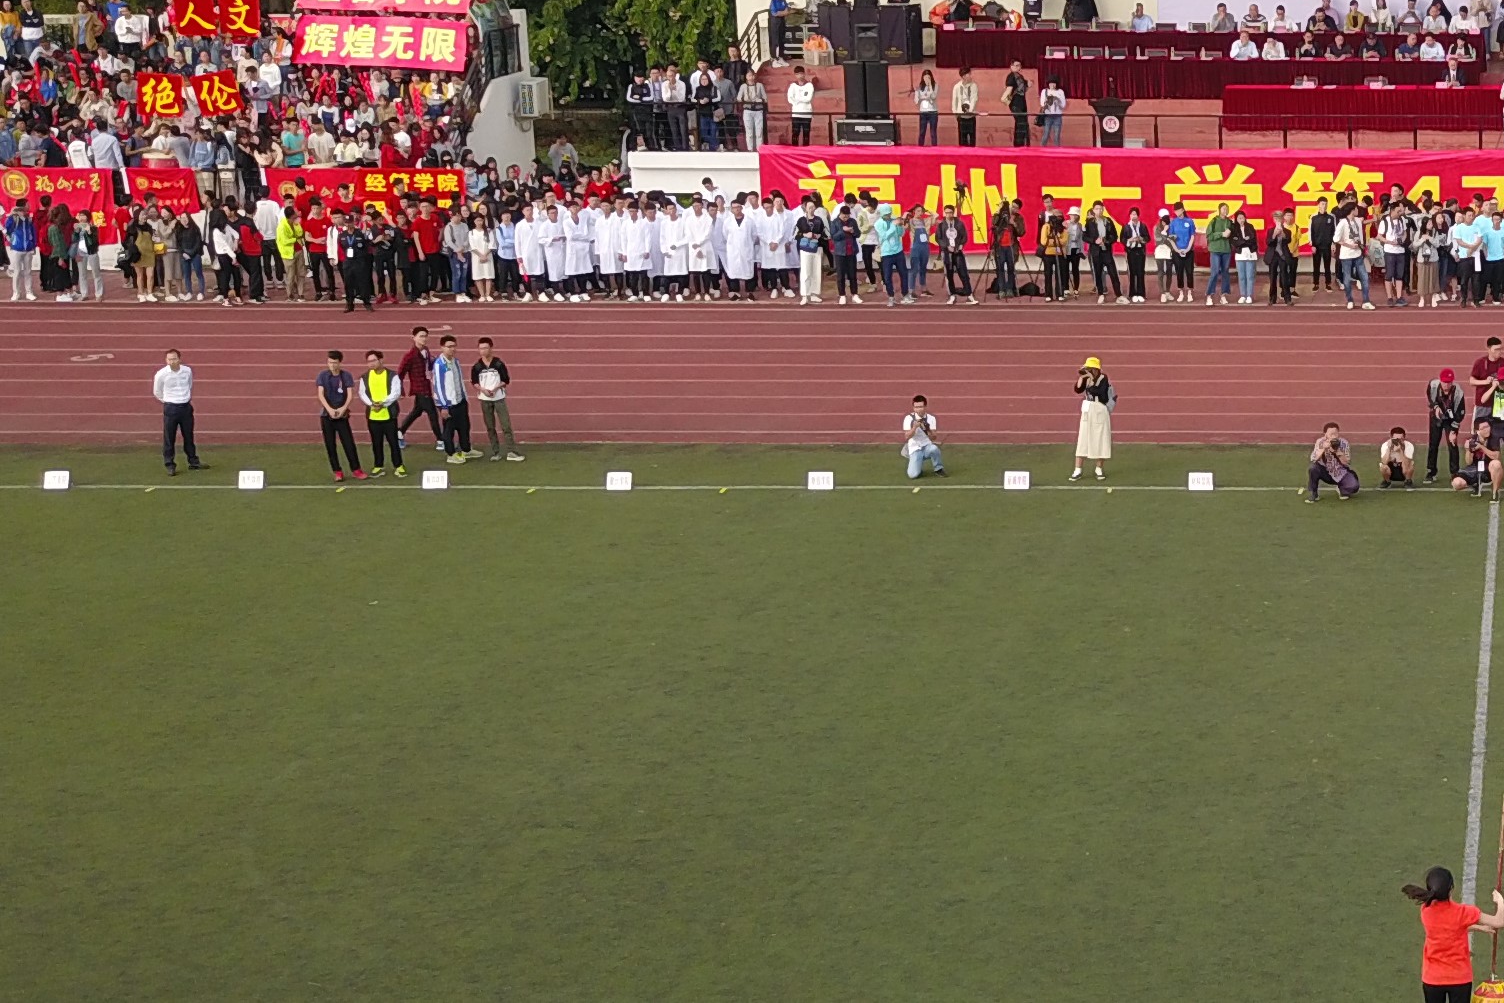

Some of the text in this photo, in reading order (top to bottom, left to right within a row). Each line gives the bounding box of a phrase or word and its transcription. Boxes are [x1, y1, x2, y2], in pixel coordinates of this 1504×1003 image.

[300, 22, 457, 64] 辉煌无限
[142, 75, 238, 114] 绝伦
